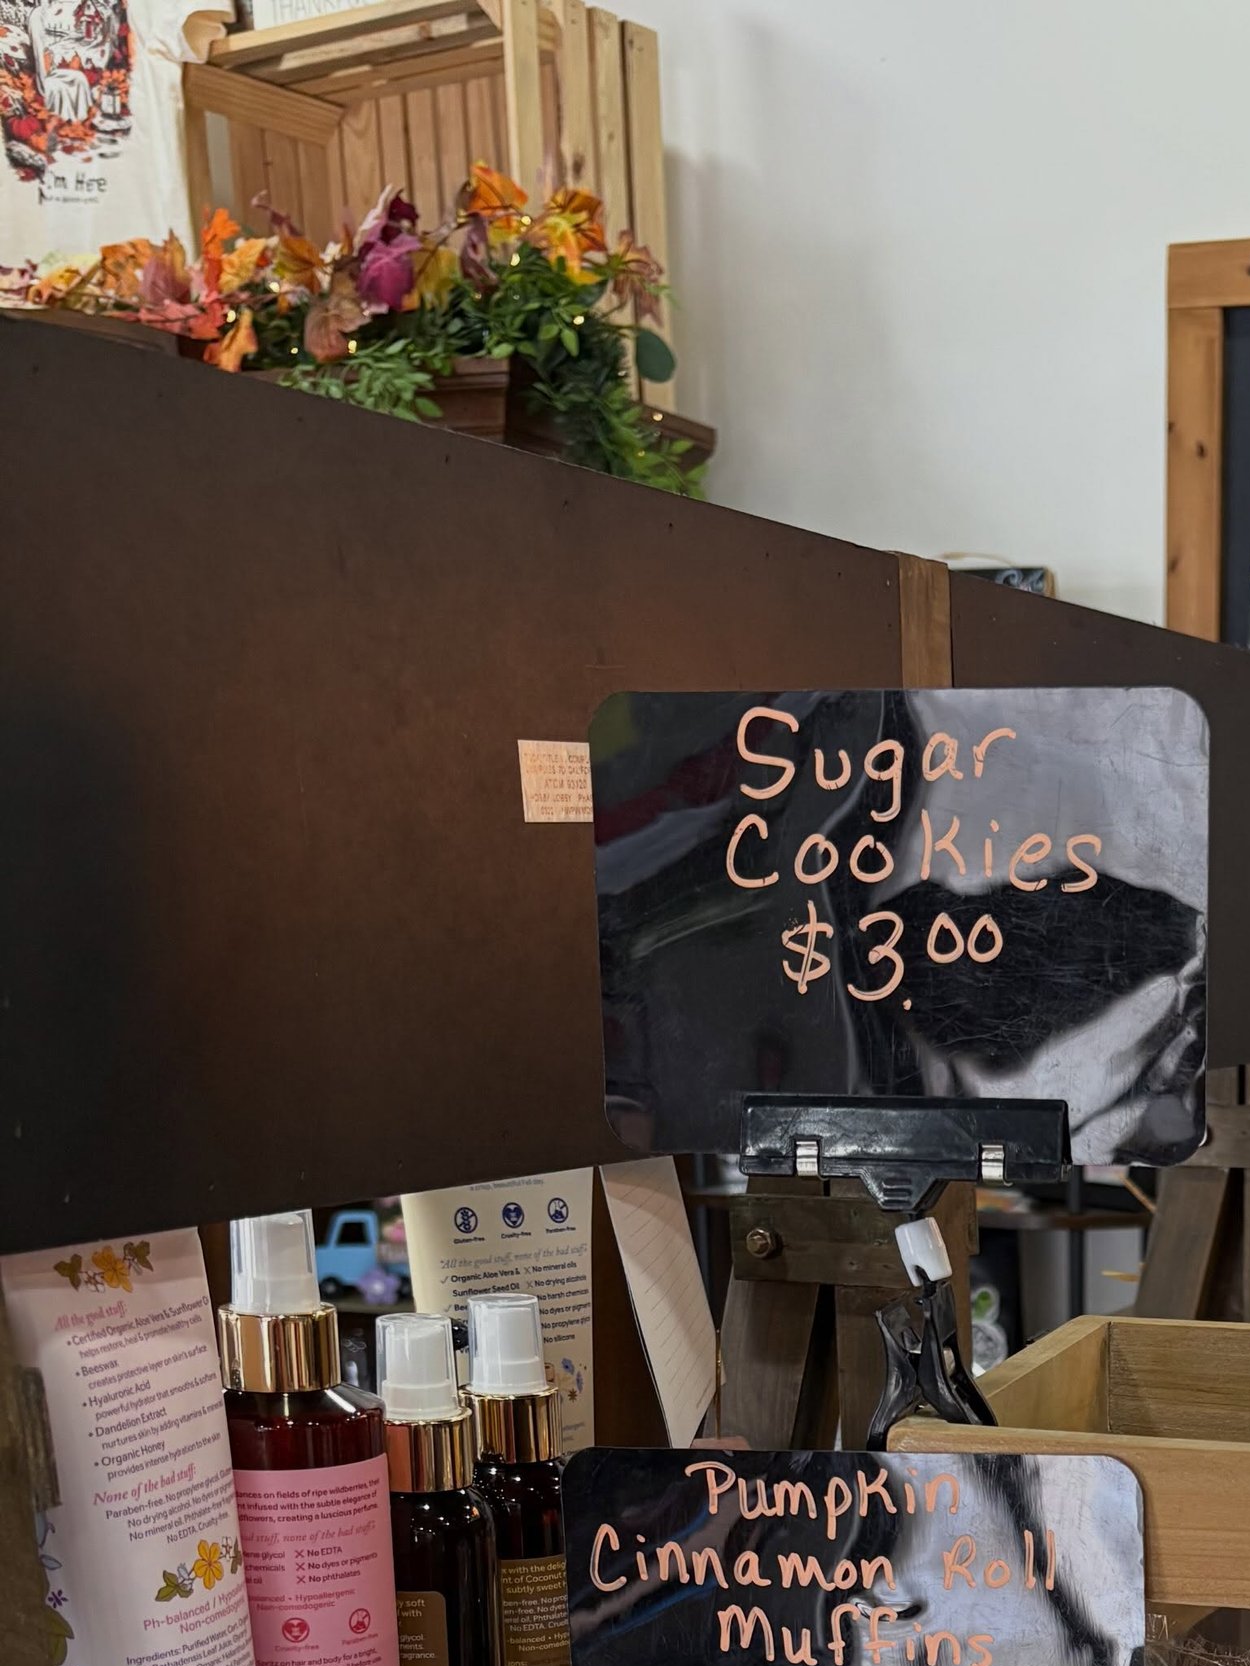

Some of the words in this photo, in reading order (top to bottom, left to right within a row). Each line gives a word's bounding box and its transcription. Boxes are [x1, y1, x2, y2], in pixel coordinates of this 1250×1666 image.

[736, 706, 1016, 822] Sugar
[725, 809, 1102, 893] Cookies
[782, 900, 1003, 1011] $3.00
[451, 1272, 482, 1283] Organic
[483, 1270, 499, 1280] Aloe
[499, 1269, 515, 1278] Vera
[543, 1263, 566, 1272] mineral
[452, 1287, 491, 1297] Sunflower
[493, 1285, 510, 1293] Seed
[72, 1327, 106, 1346] Certified
[107, 1321, 135, 1338] Organic
[81, 1359, 119, 1377] Beeswax
[88, 1376, 117, 1390] creates
[117, 1366, 149, 1382] protective
[88, 1387, 134, 1408] Hyaluronic
[135, 1380, 151, 1394] Acid
[95, 1403, 129, 1421] powerful
[95, 1418, 141, 1437] Dandelion
[141, 1407, 167, 1422] Extract
[102, 1434, 137, 1450] nurtures
[101, 1449, 140, 1467] Organic
[141, 1440, 166, 1455] Honey
[107, 1463, 144, 1482] provides
[93, 1490, 128, 1505] None
[131, 1483, 143, 1501] of
[145, 1479, 159, 1494] the
[160, 1471, 175, 1487] bad
[277, 1491, 300, 1499] fields
[302, 1490, 311, 1498] of
[312, 1489, 328, 1499] ripe
[106, 1497, 165, 1519] Paraben-free.
[247, 1502, 278, 1511] infused
[300, 1501, 315, 1509] the
[317, 1499, 341, 1508] subtle
[685, 1461, 961, 1540] Pumpkin
[128, 1517, 141, 1528] No
[278, 1512, 313, 1523] creating
[321, 1509, 351, 1519] luscious
[129, 1529, 143, 1541] No
[167, 1534, 178, 1543] No
[321, 1546, 343, 1555] EDTA
[590, 1523, 897, 1592] Cinnamon
[943, 1529, 1056, 1591] Roll
[322, 1557, 340, 1570] dyes
[509, 1566, 528, 1574] with
[530, 1564, 545, 1572] the
[526, 1572, 561, 1583] Coconut
[506, 1586, 534, 1594] subtly
[143, 1601, 210, 1631] Ph-balanced
[126, 1647, 181, 1665] Ingredients:
